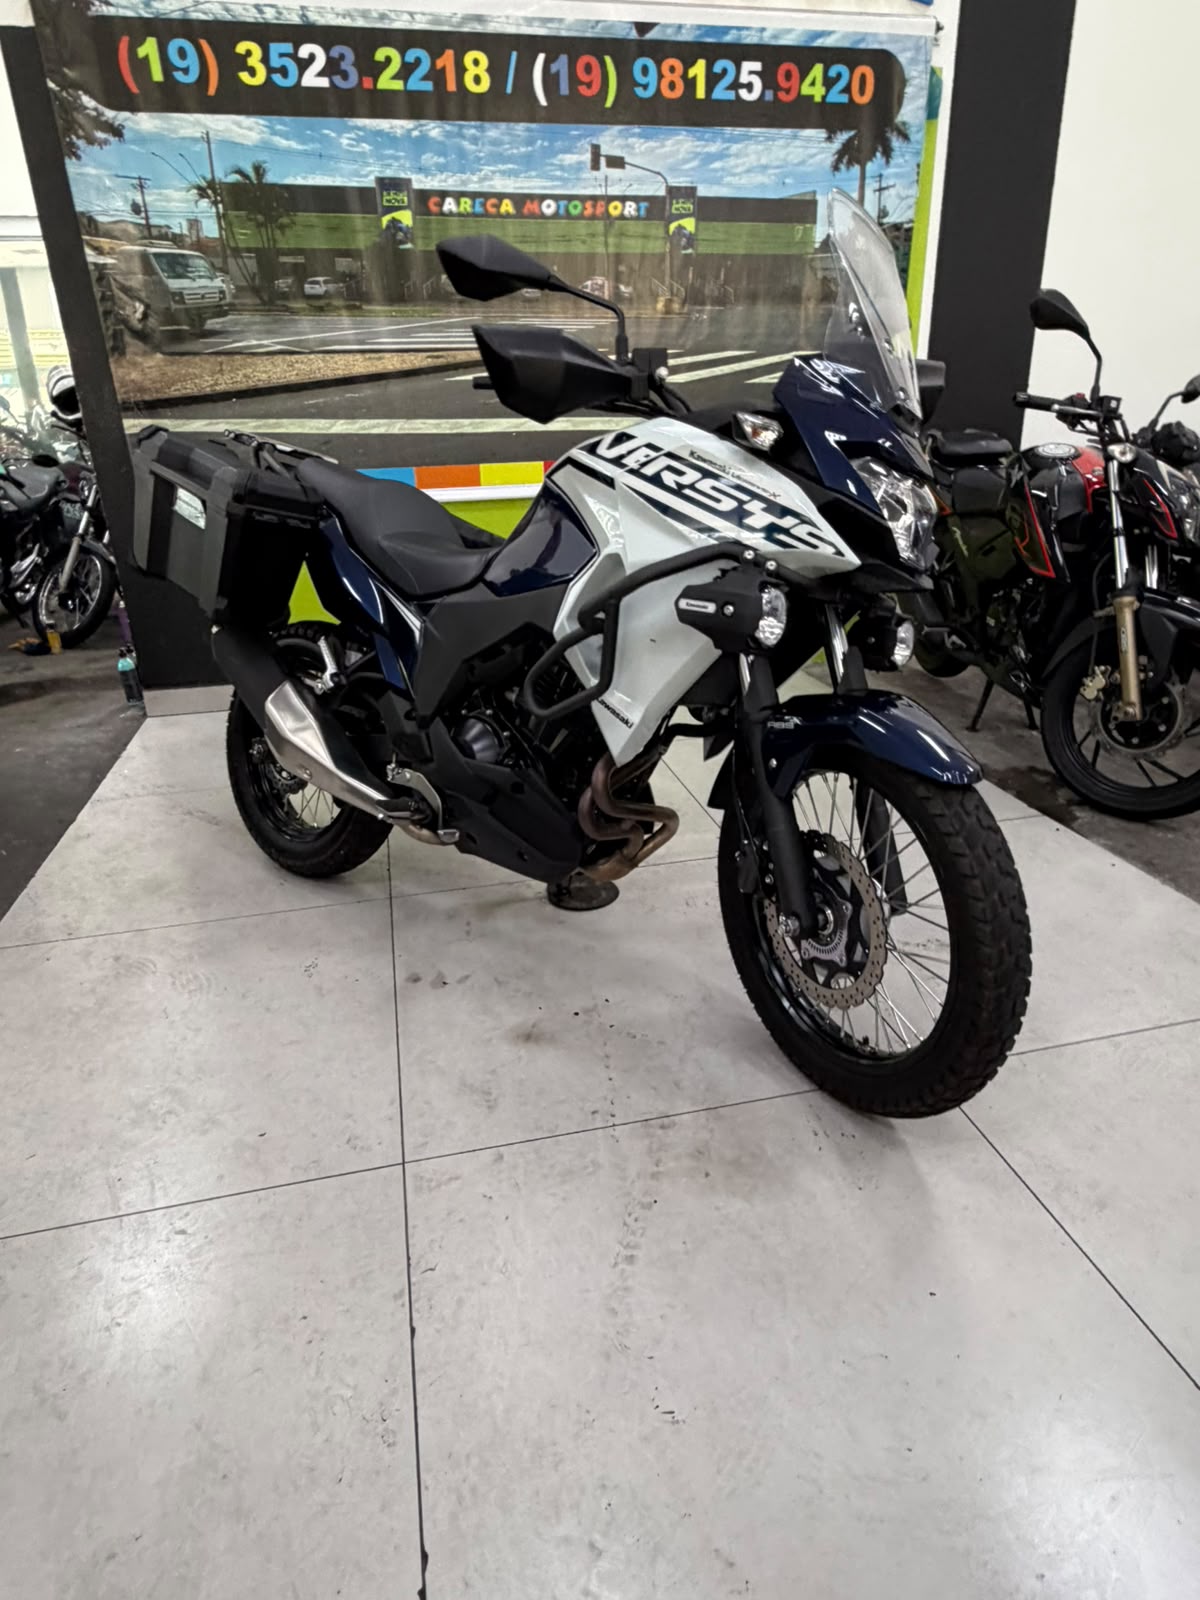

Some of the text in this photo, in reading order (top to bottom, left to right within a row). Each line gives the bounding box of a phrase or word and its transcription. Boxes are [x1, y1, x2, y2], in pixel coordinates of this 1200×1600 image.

[117, 35, 219, 96] (19)
[234, 41, 491, 94] 3523.2218
[532, 52, 618, 108] (19)
[632, 56, 875, 105] 98125.9420
[427, 196, 649, 218] CARECA MOTOSPORT
